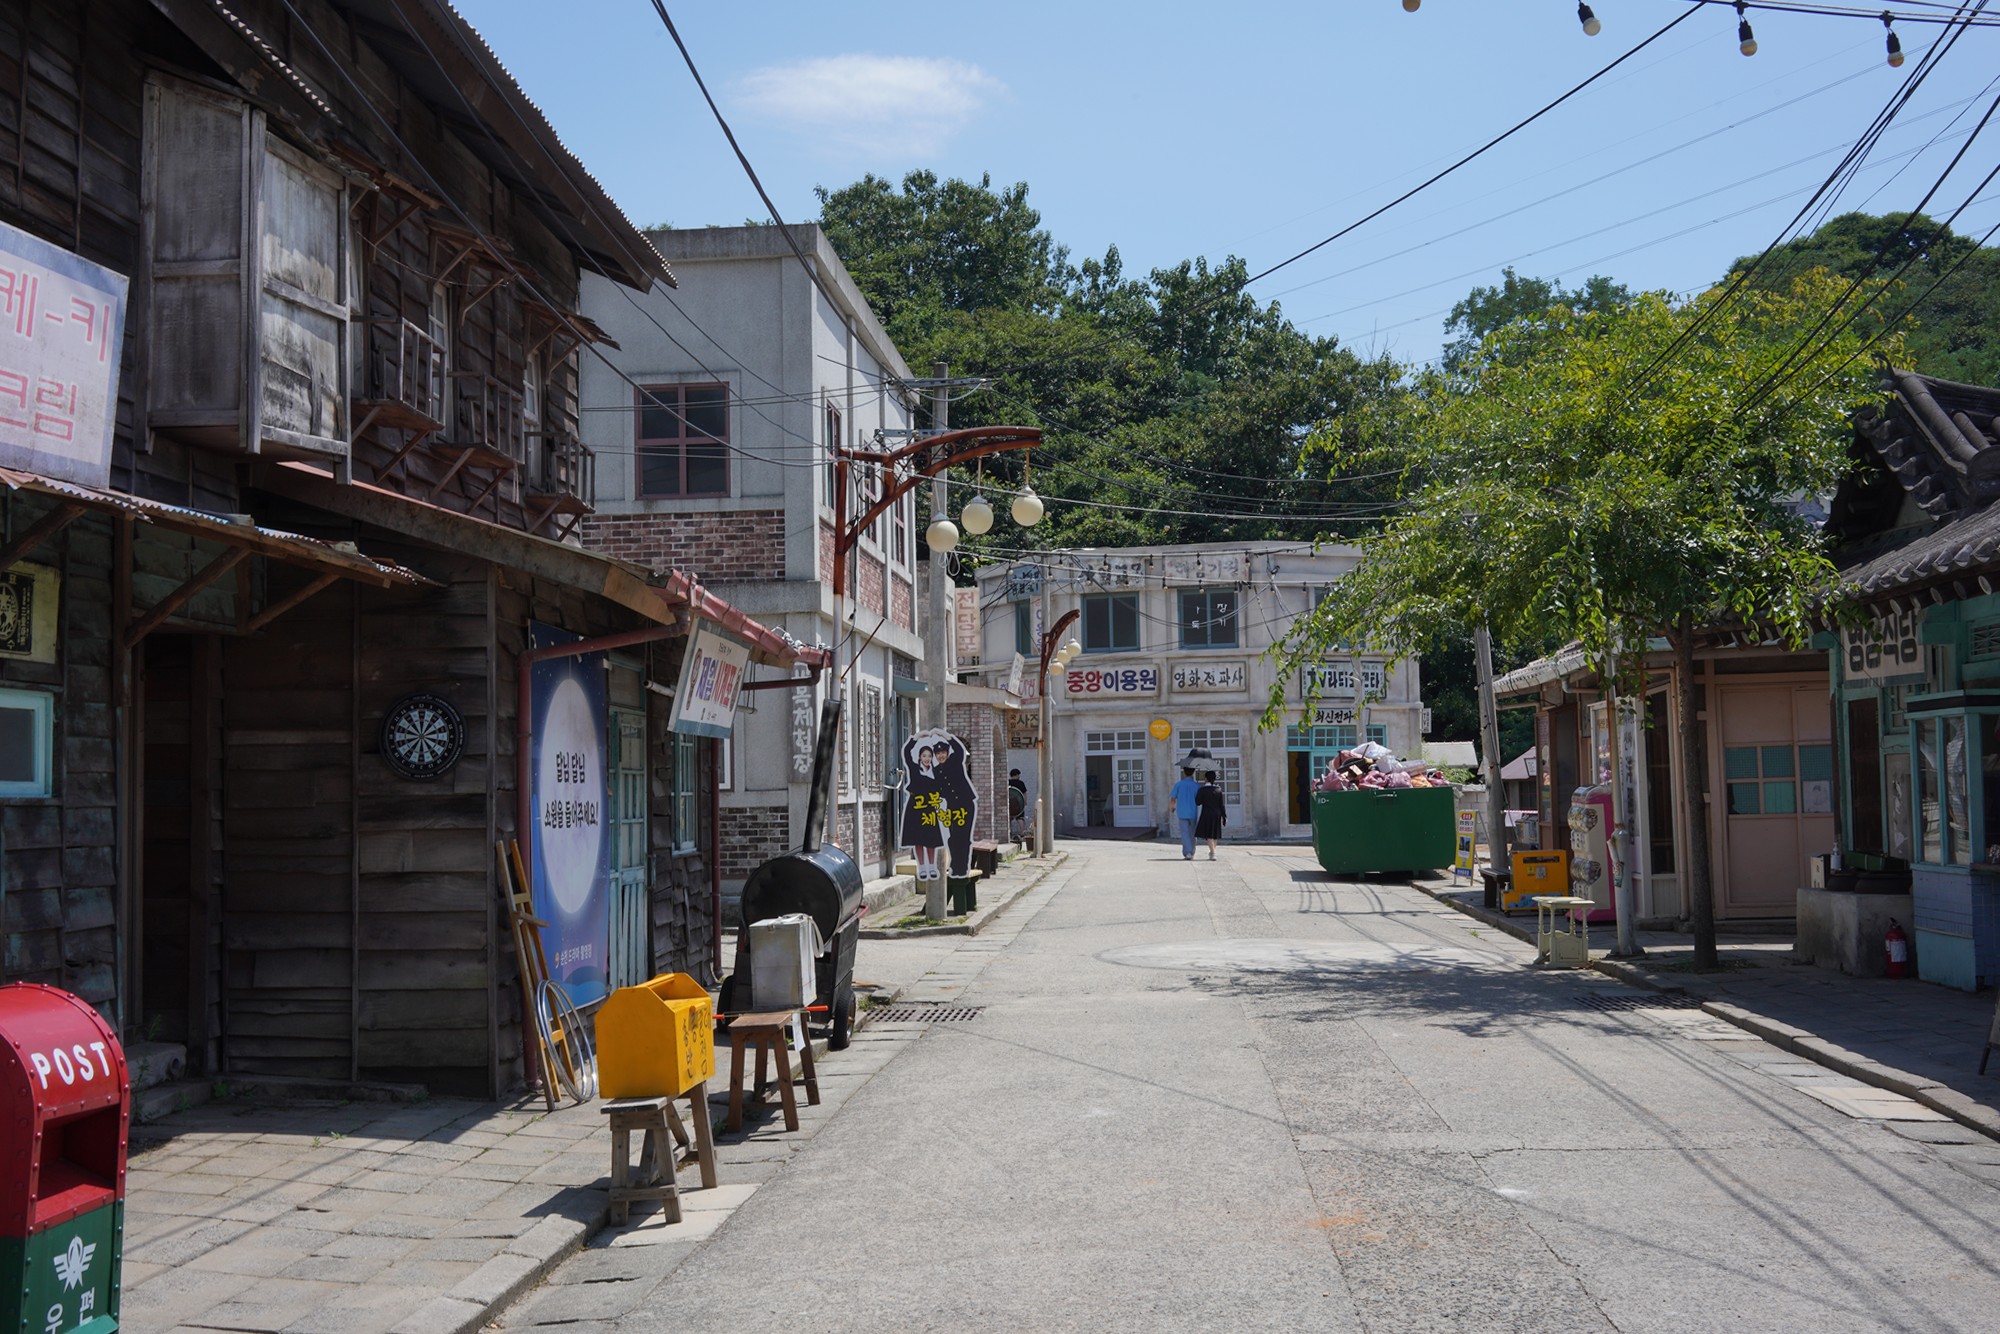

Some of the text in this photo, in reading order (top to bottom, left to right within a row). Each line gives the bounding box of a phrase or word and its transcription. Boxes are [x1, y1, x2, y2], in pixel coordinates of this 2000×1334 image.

[1066, 669, 1157, 693] 중앙이용원
[1173, 667, 1243, 689] 영화전파사
[556, 752, 585, 784] 달님 달님
[913, 792, 943, 810] 교복
[544, 800, 599, 829] 소원을 들어주세요!
[921, 807, 968, 827] 체험장
[31, 1042, 110, 1089] POST
